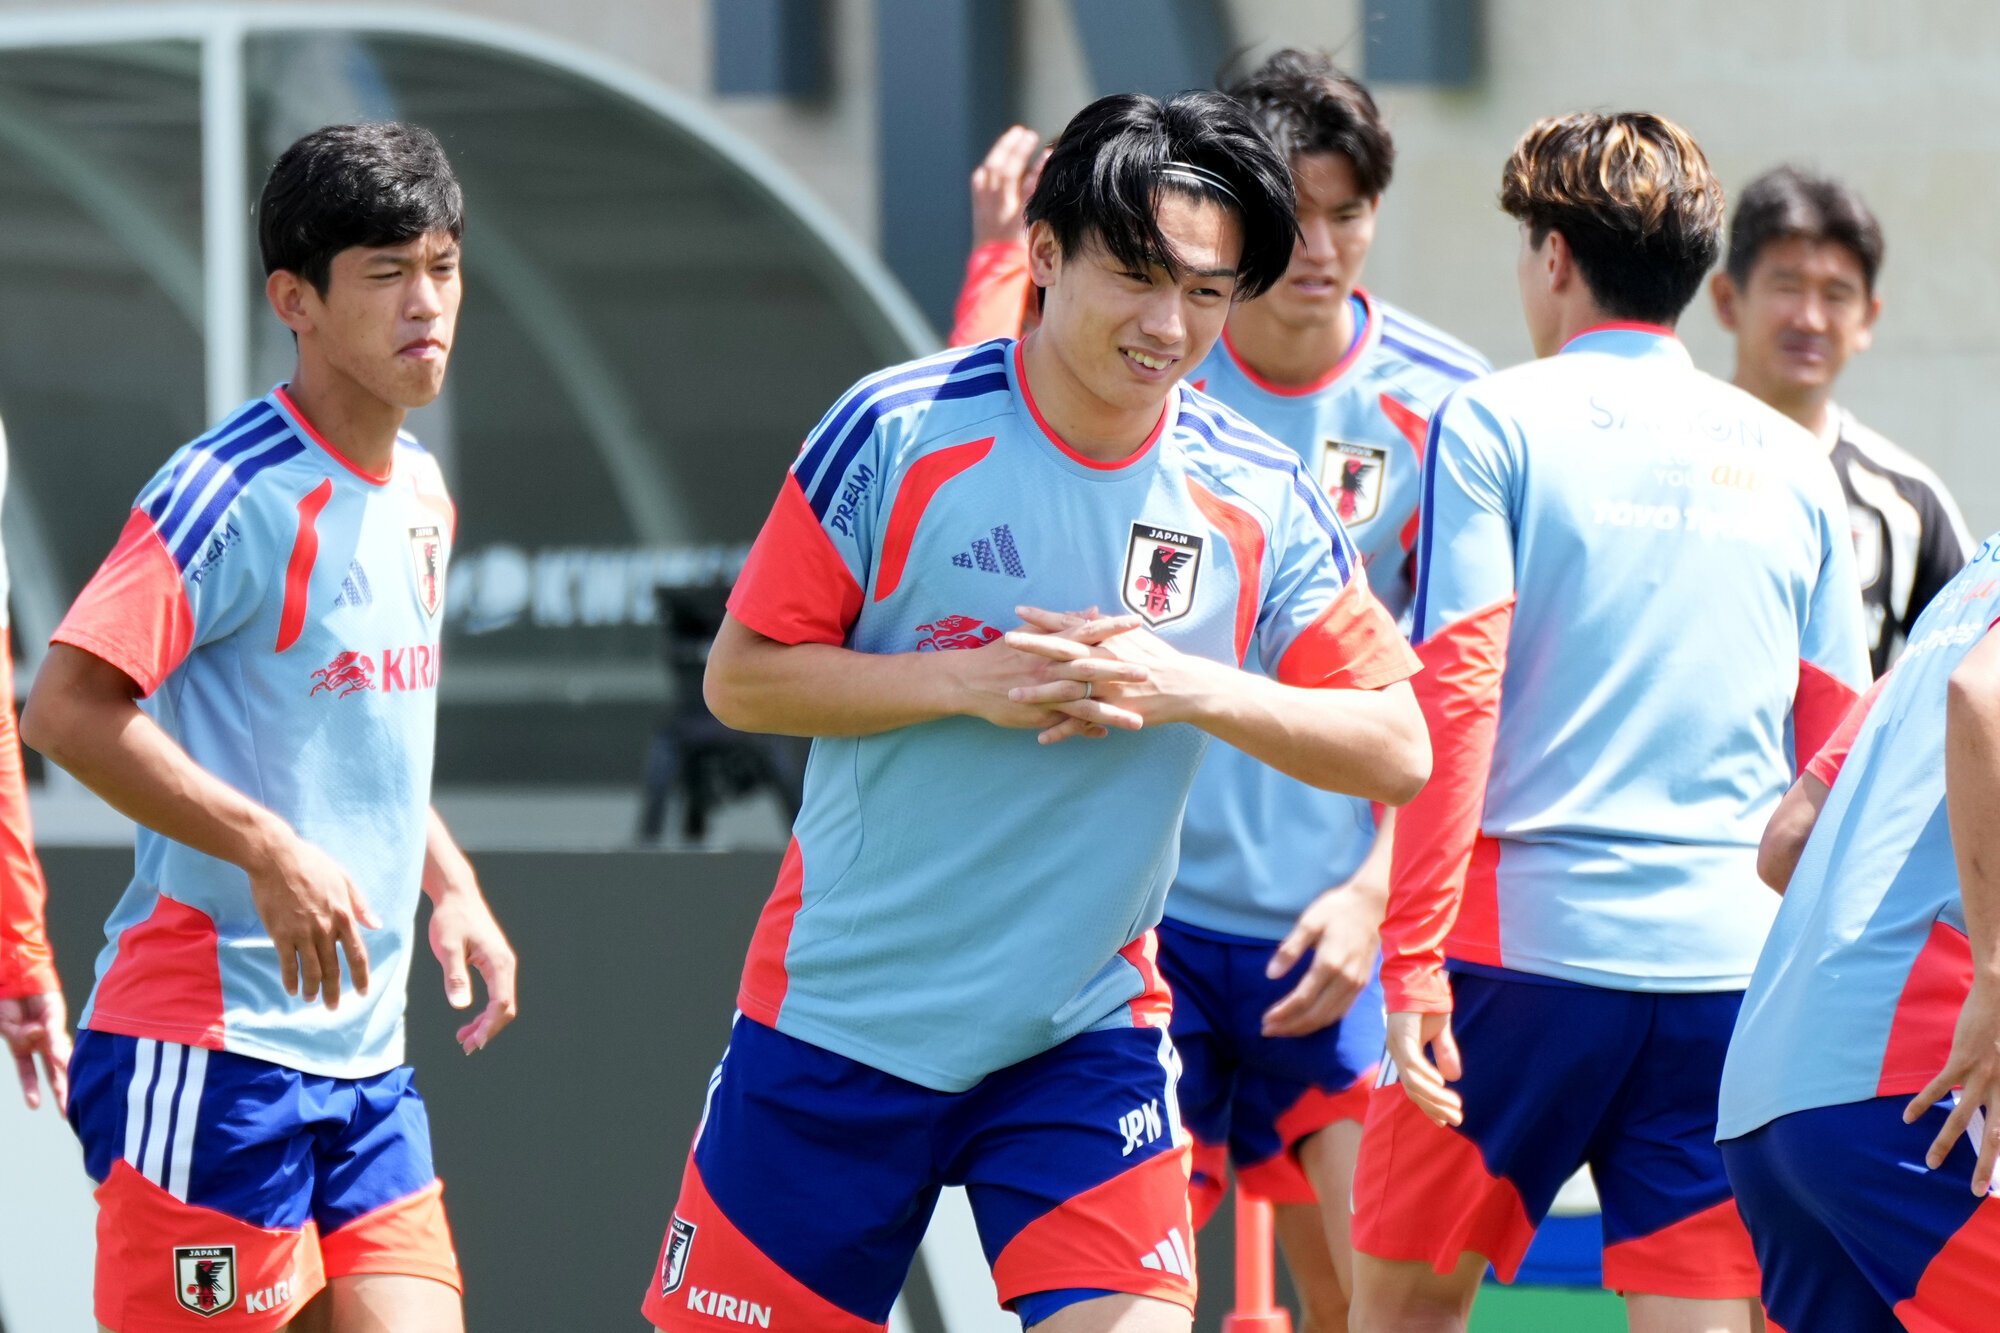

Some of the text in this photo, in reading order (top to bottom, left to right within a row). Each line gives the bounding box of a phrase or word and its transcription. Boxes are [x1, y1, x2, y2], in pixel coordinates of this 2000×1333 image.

[831, 464, 875, 536] DREAM
[1149, 529, 1188, 545] JAPAN
[1140, 595, 1171, 613] JFA
[1118, 1098, 1162, 1157] JPN
[687, 1286, 771, 1329] KIRIN
